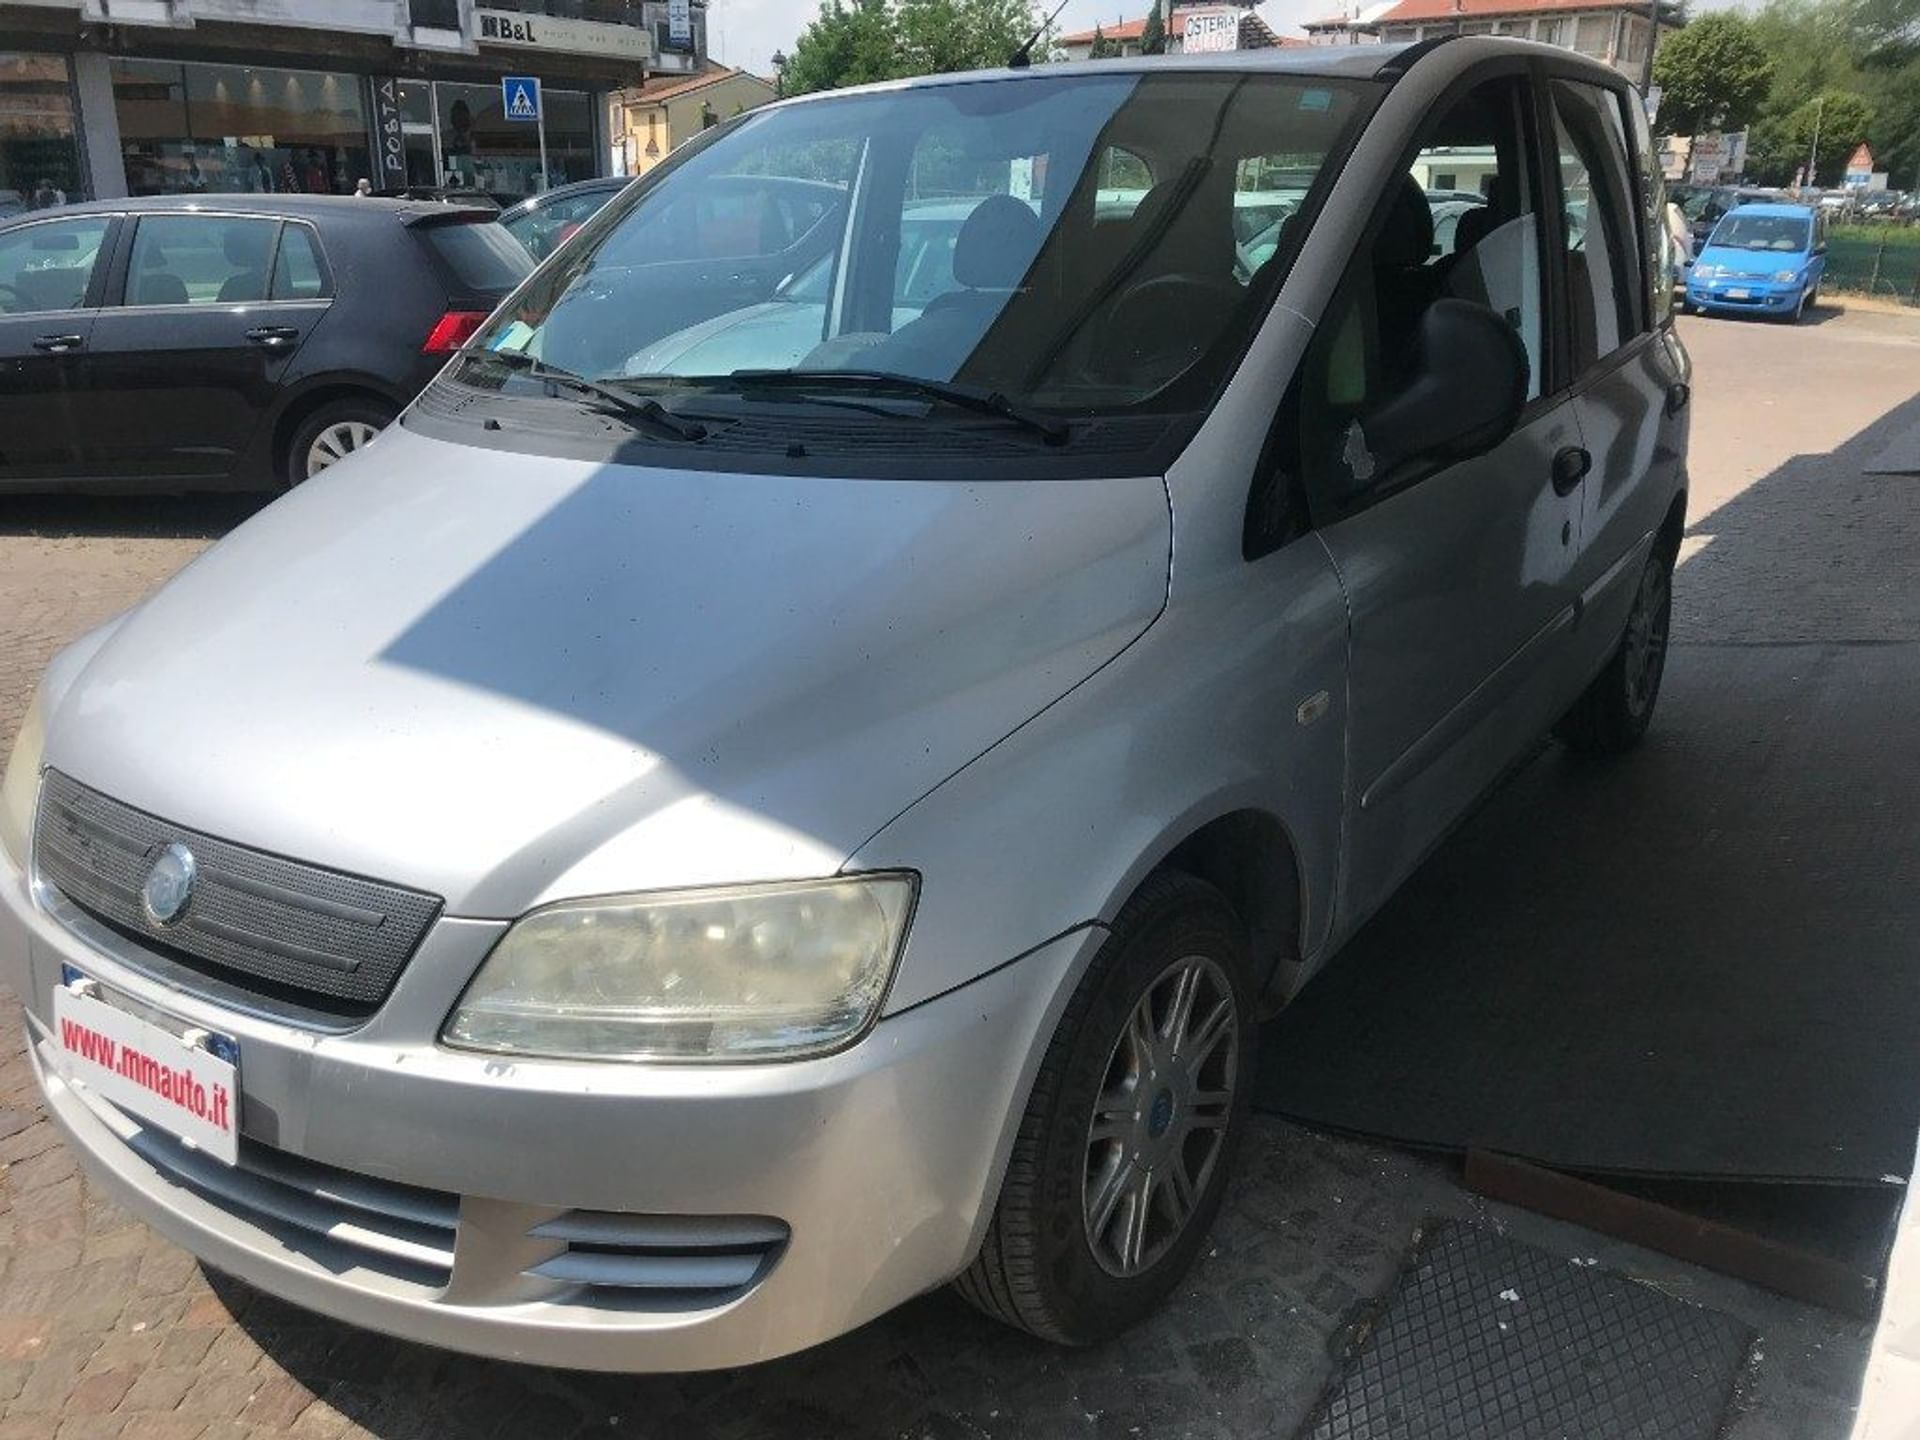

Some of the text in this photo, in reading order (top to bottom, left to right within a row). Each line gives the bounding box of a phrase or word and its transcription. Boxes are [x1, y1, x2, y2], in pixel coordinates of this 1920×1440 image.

[499, 17, 536, 42] B&L
[380, 79, 403, 171] POSTA
[61, 1017, 229, 1131] www.mmauto.it
